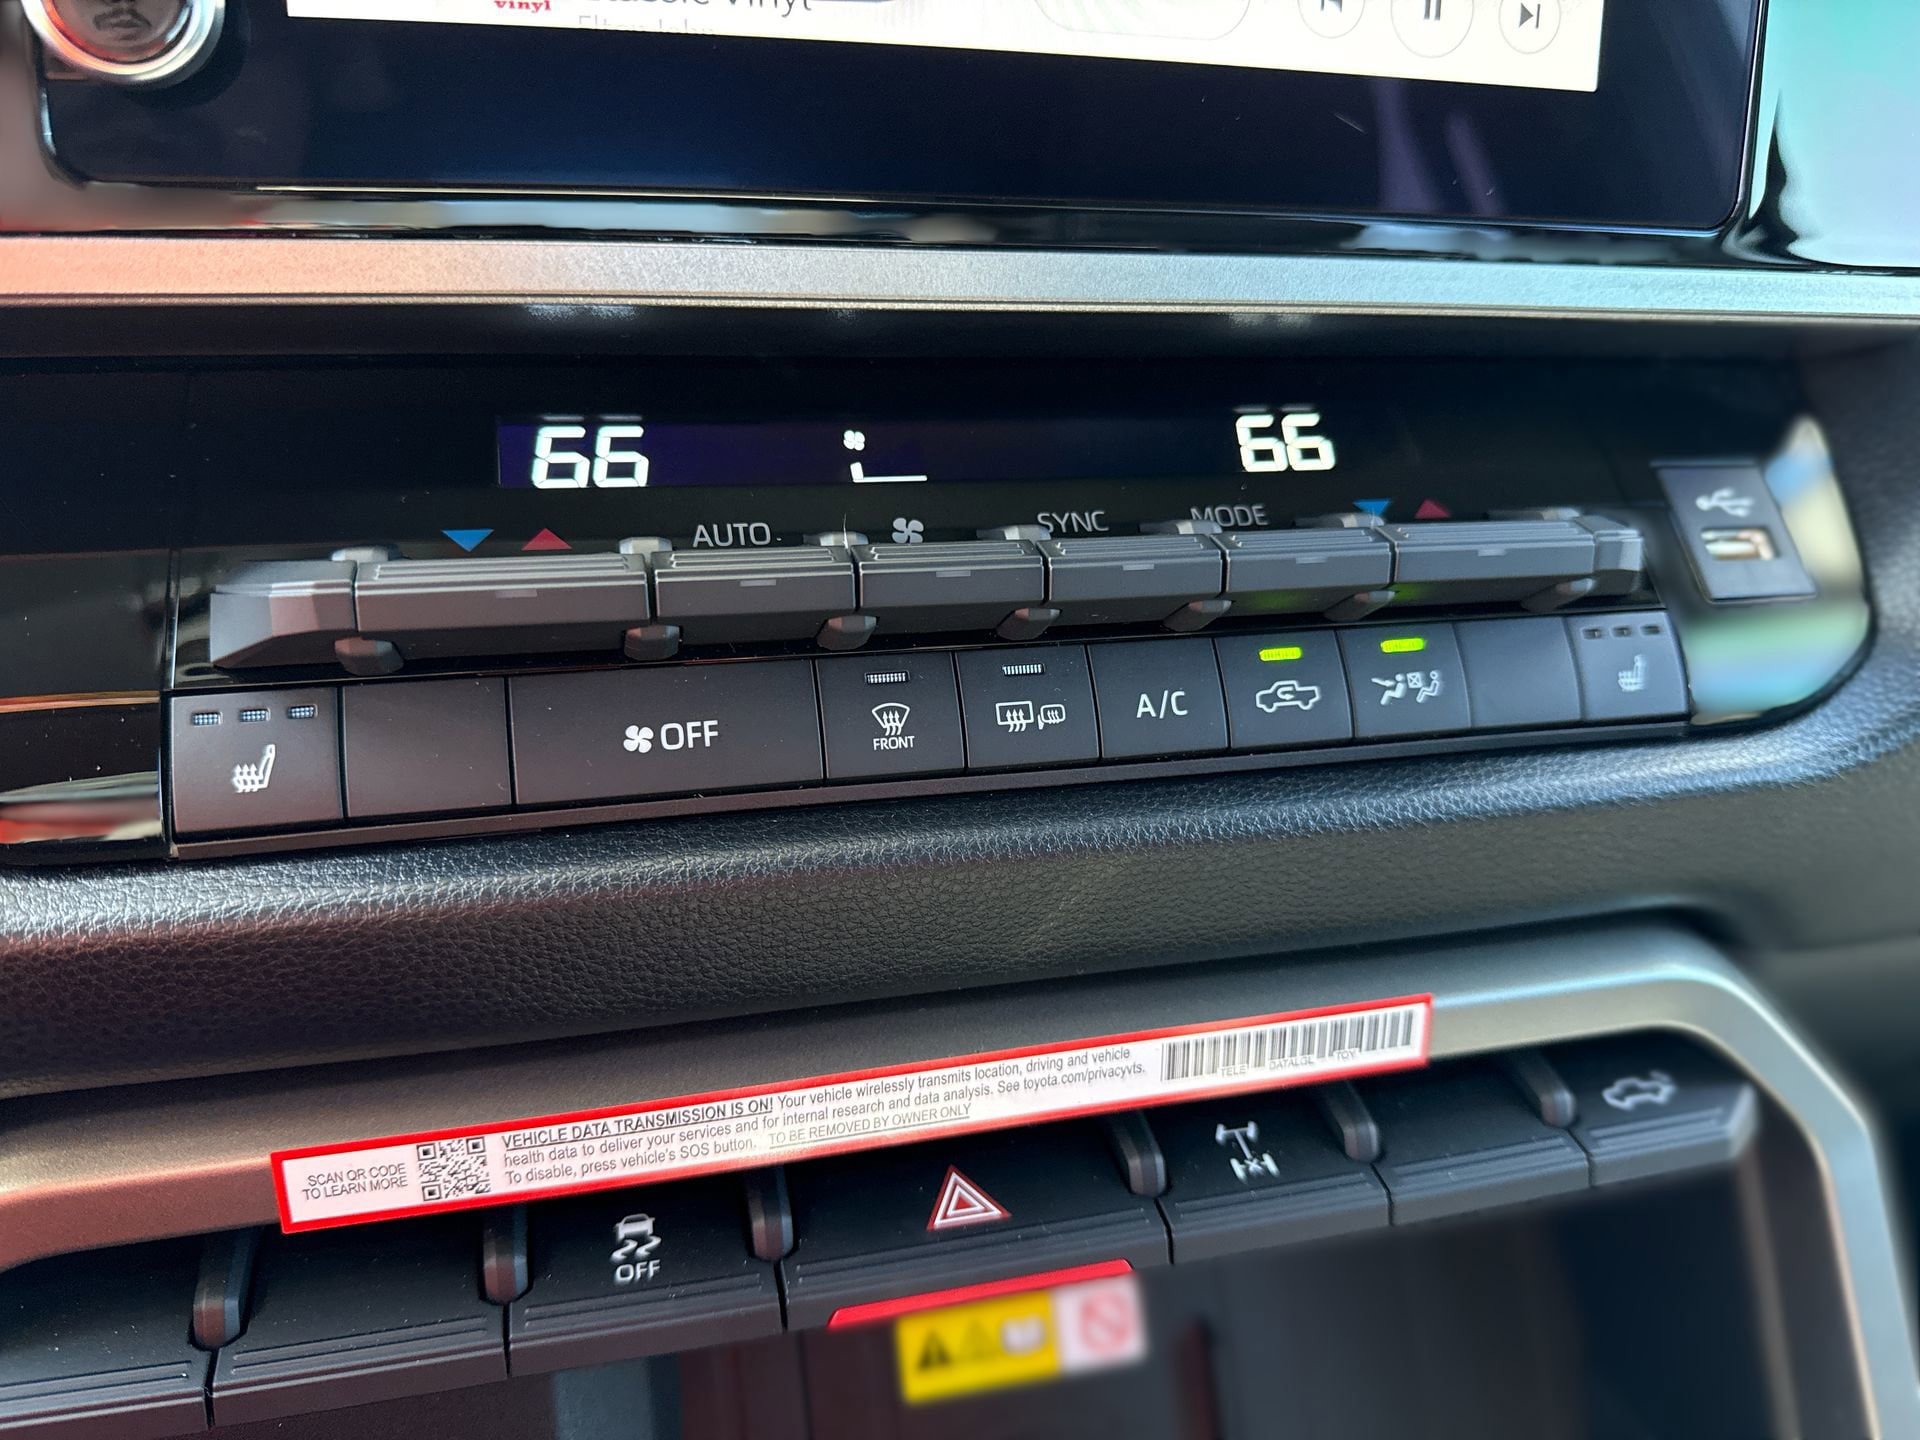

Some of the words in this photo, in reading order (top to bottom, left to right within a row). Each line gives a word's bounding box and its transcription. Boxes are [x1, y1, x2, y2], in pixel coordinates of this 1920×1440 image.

[1236, 413, 1336, 472] 66
[531, 425, 650, 489] 66
[1037, 511, 1109, 532] SYNC
[1190, 506, 1268, 527] MODE
[692, 522, 772, 548] AUTO
[1136, 690, 1188, 719] A/C
[660, 720, 719, 750] OFF
[873, 735, 915, 751] FRONT
[1221, 1064, 1246, 1078] TELE
[501, 1127, 567, 1149] VEHICLE
[572, 1120, 611, 1140] DATA
[614, 1103, 726, 1132] TRANSMISSION
[731, 1101, 744, 1115] IS
[748, 1097, 773, 1113] ON!
[777, 1094, 807, 1109] Your
[809, 1087, 852, 1104] vehicle
[856, 1078, 915, 1095] wirelessly
[918, 1068, 971, 1086] transmits
[974, 1063, 1023, 1081] location,
[1026, 1058, 1064, 1073] driving
[1067, 1052, 1088, 1067] and
[1092, 1047, 1130, 1062] vehicle
[504, 1150, 545, 1167] health
[548, 1146, 578, 1161] data
[582, 1143, 595, 1156] to
[600, 1136, 643, 1153] deliver
[646, 1131, 676, 1148] your
[679, 1123, 731, 1141] services
[735, 1117, 759, 1132] and
[762, 1115, 779, 1129] for
[783, 1107, 828, 1126] internal
[832, 1100, 885, 1119] research
[888, 1095, 911, 1110] and
[914, 1091, 940, 1106] data
[943, 1083, 994, 1101] analysis.
[997, 1080, 1020, 1094] See
[1023, 1062, 1145, 1091] toyota.com/privacyvts.
[505, 1171, 522, 1185] To
[525, 1163, 578, 1182] disable,
[581, 1158, 617, 1177] press
[620, 1147, 676, 1168] vehicle's
[680, 1143, 710, 1159] SOS
[713, 1138, 757, 1154] button.
[769, 1131, 786, 1145] TO
[789, 1129, 807, 1141] BE
[809, 1118, 870, 1138] REMOVED
[873, 1115, 890, 1129] BY
[892, 1107, 938, 1126] OWNER
[940, 1103, 972, 1119] ONLY
[302, 1187, 321, 1201] TO
[324, 1181, 367, 1198] LEARN
[370, 1175, 409, 1194] MORE
[307, 1171, 343, 1187] SCAN
[347, 1168, 367, 1183] QR
[368, 1163, 406, 1179] CODE
[614, 1259, 661, 1284] OFF
